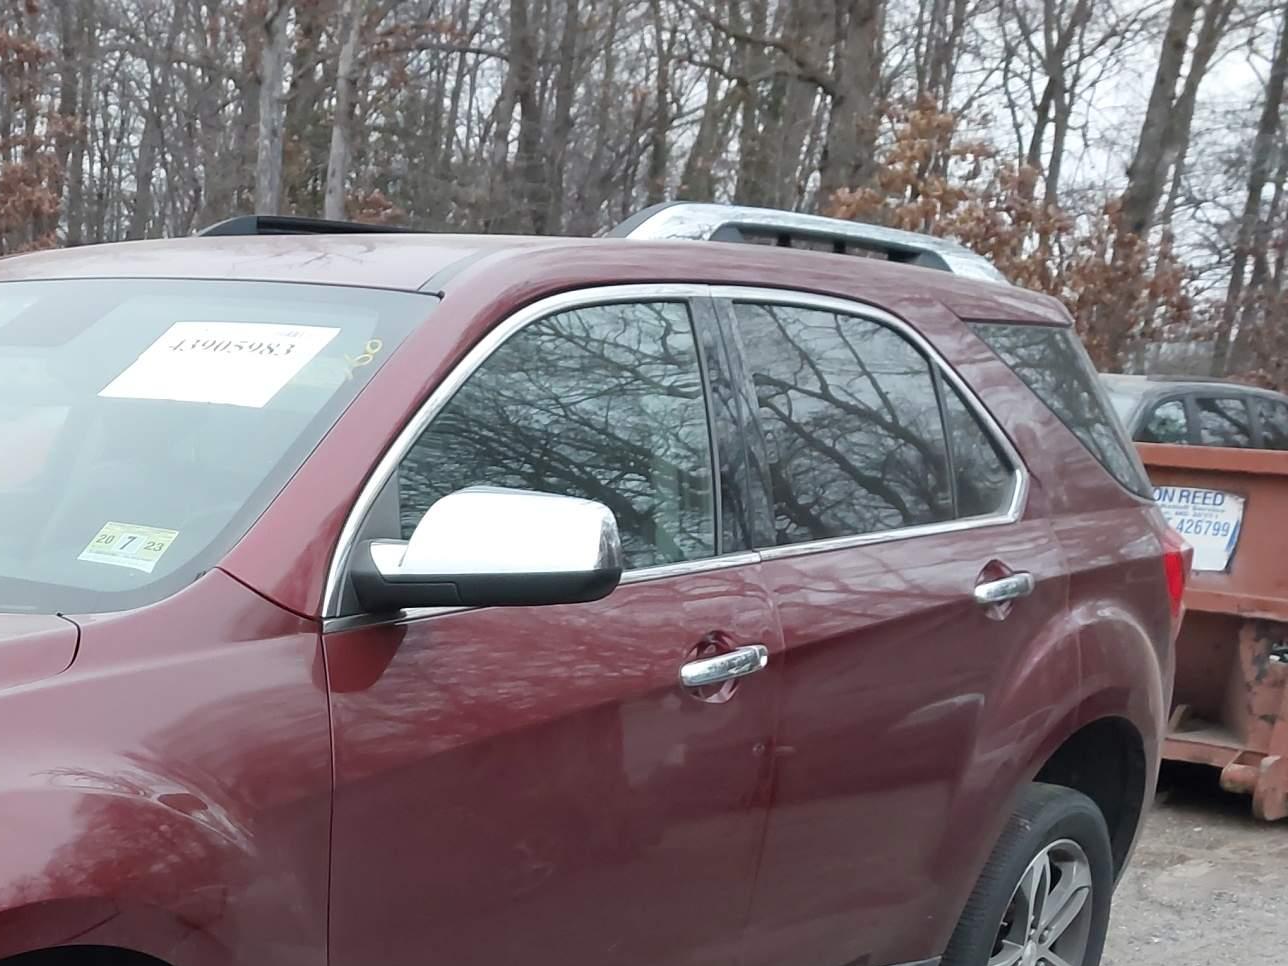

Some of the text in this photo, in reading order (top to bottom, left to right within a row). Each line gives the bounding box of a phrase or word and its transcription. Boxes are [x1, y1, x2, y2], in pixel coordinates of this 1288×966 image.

[169, 339, 296, 356] 43905983
[1178, 489, 1225, 506] REED
[1176, 518, 1231, 537] 426799
[96, 534, 165, 552] 20 7 23
